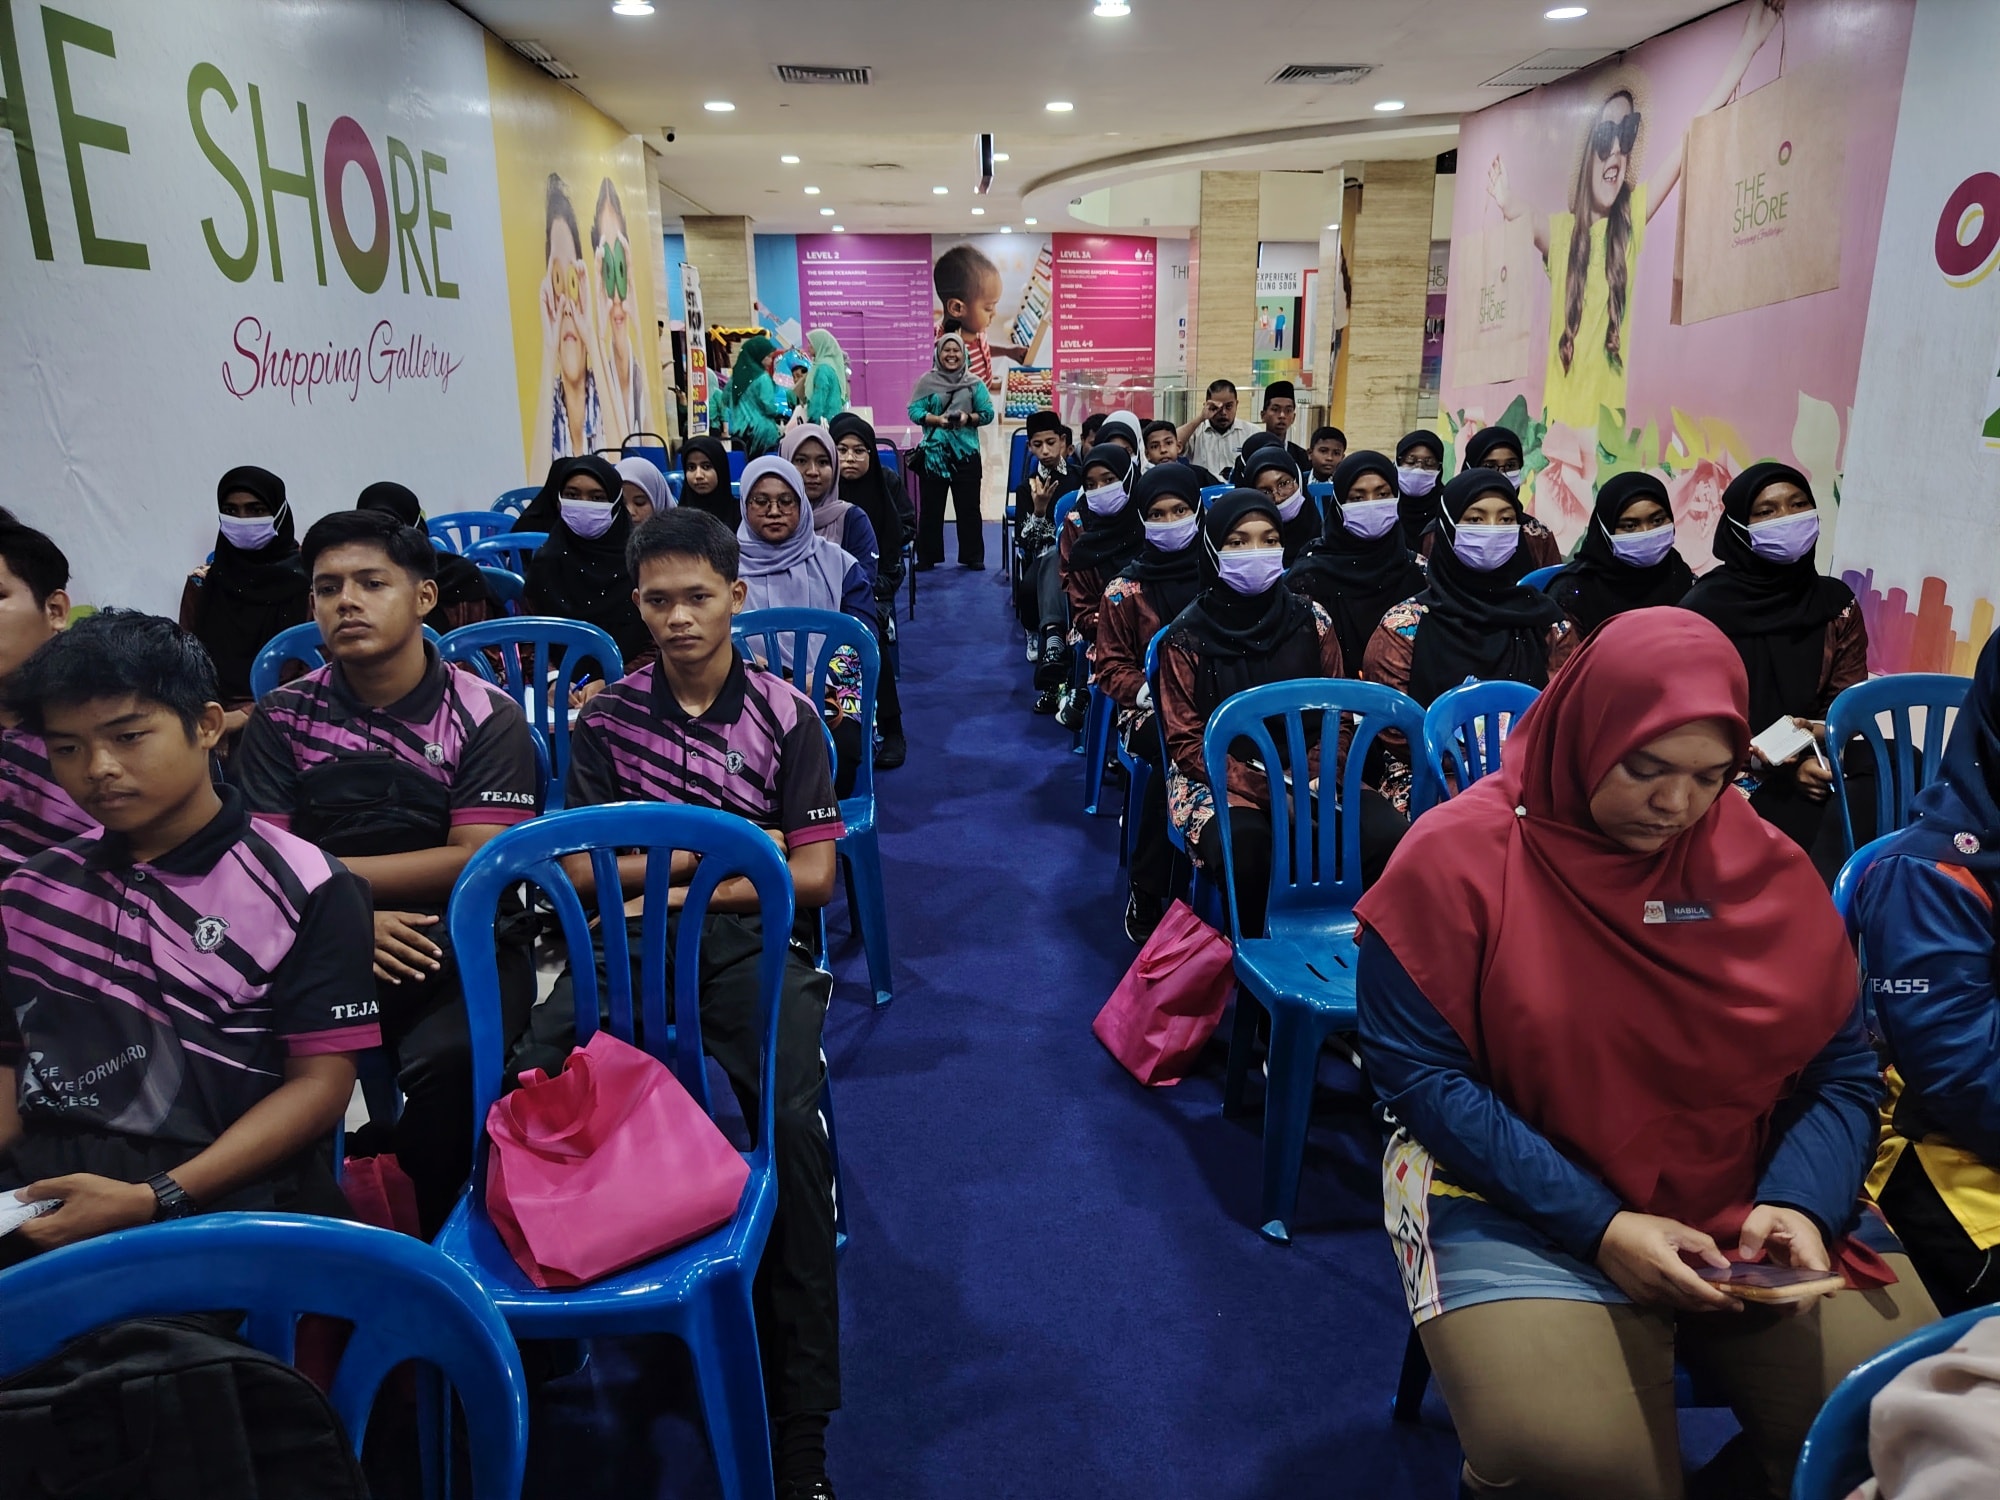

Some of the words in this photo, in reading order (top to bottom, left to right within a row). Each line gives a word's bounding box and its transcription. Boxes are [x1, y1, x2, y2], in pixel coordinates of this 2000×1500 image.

[187, 61, 460, 299] SHORE
[1735, 173, 1766, 206] THE
[1733, 192, 1789, 234] SHORE
[806, 251, 832, 260] LEVEL
[834, 251, 840, 260] 2
[1060, 251, 1080, 259] LEVEL
[1256, 272, 1297, 282] EXPERIENCE
[1279, 282, 1297, 290] SOON
[1481, 284, 1495, 305] THE
[1479, 300, 1506, 324] SHORE
[1060, 340, 1081, 348] LEVEL
[1082, 340, 1093, 348] 4-6
[221, 316, 362, 405] Shopping
[367, 320, 464, 393] Gallery
[480, 791, 535, 805] TEJASS
[1674, 907, 1705, 915] NABILA
[1870, 978, 1929, 993] TEASS
[77, 1044, 147, 1092] FORWARD
